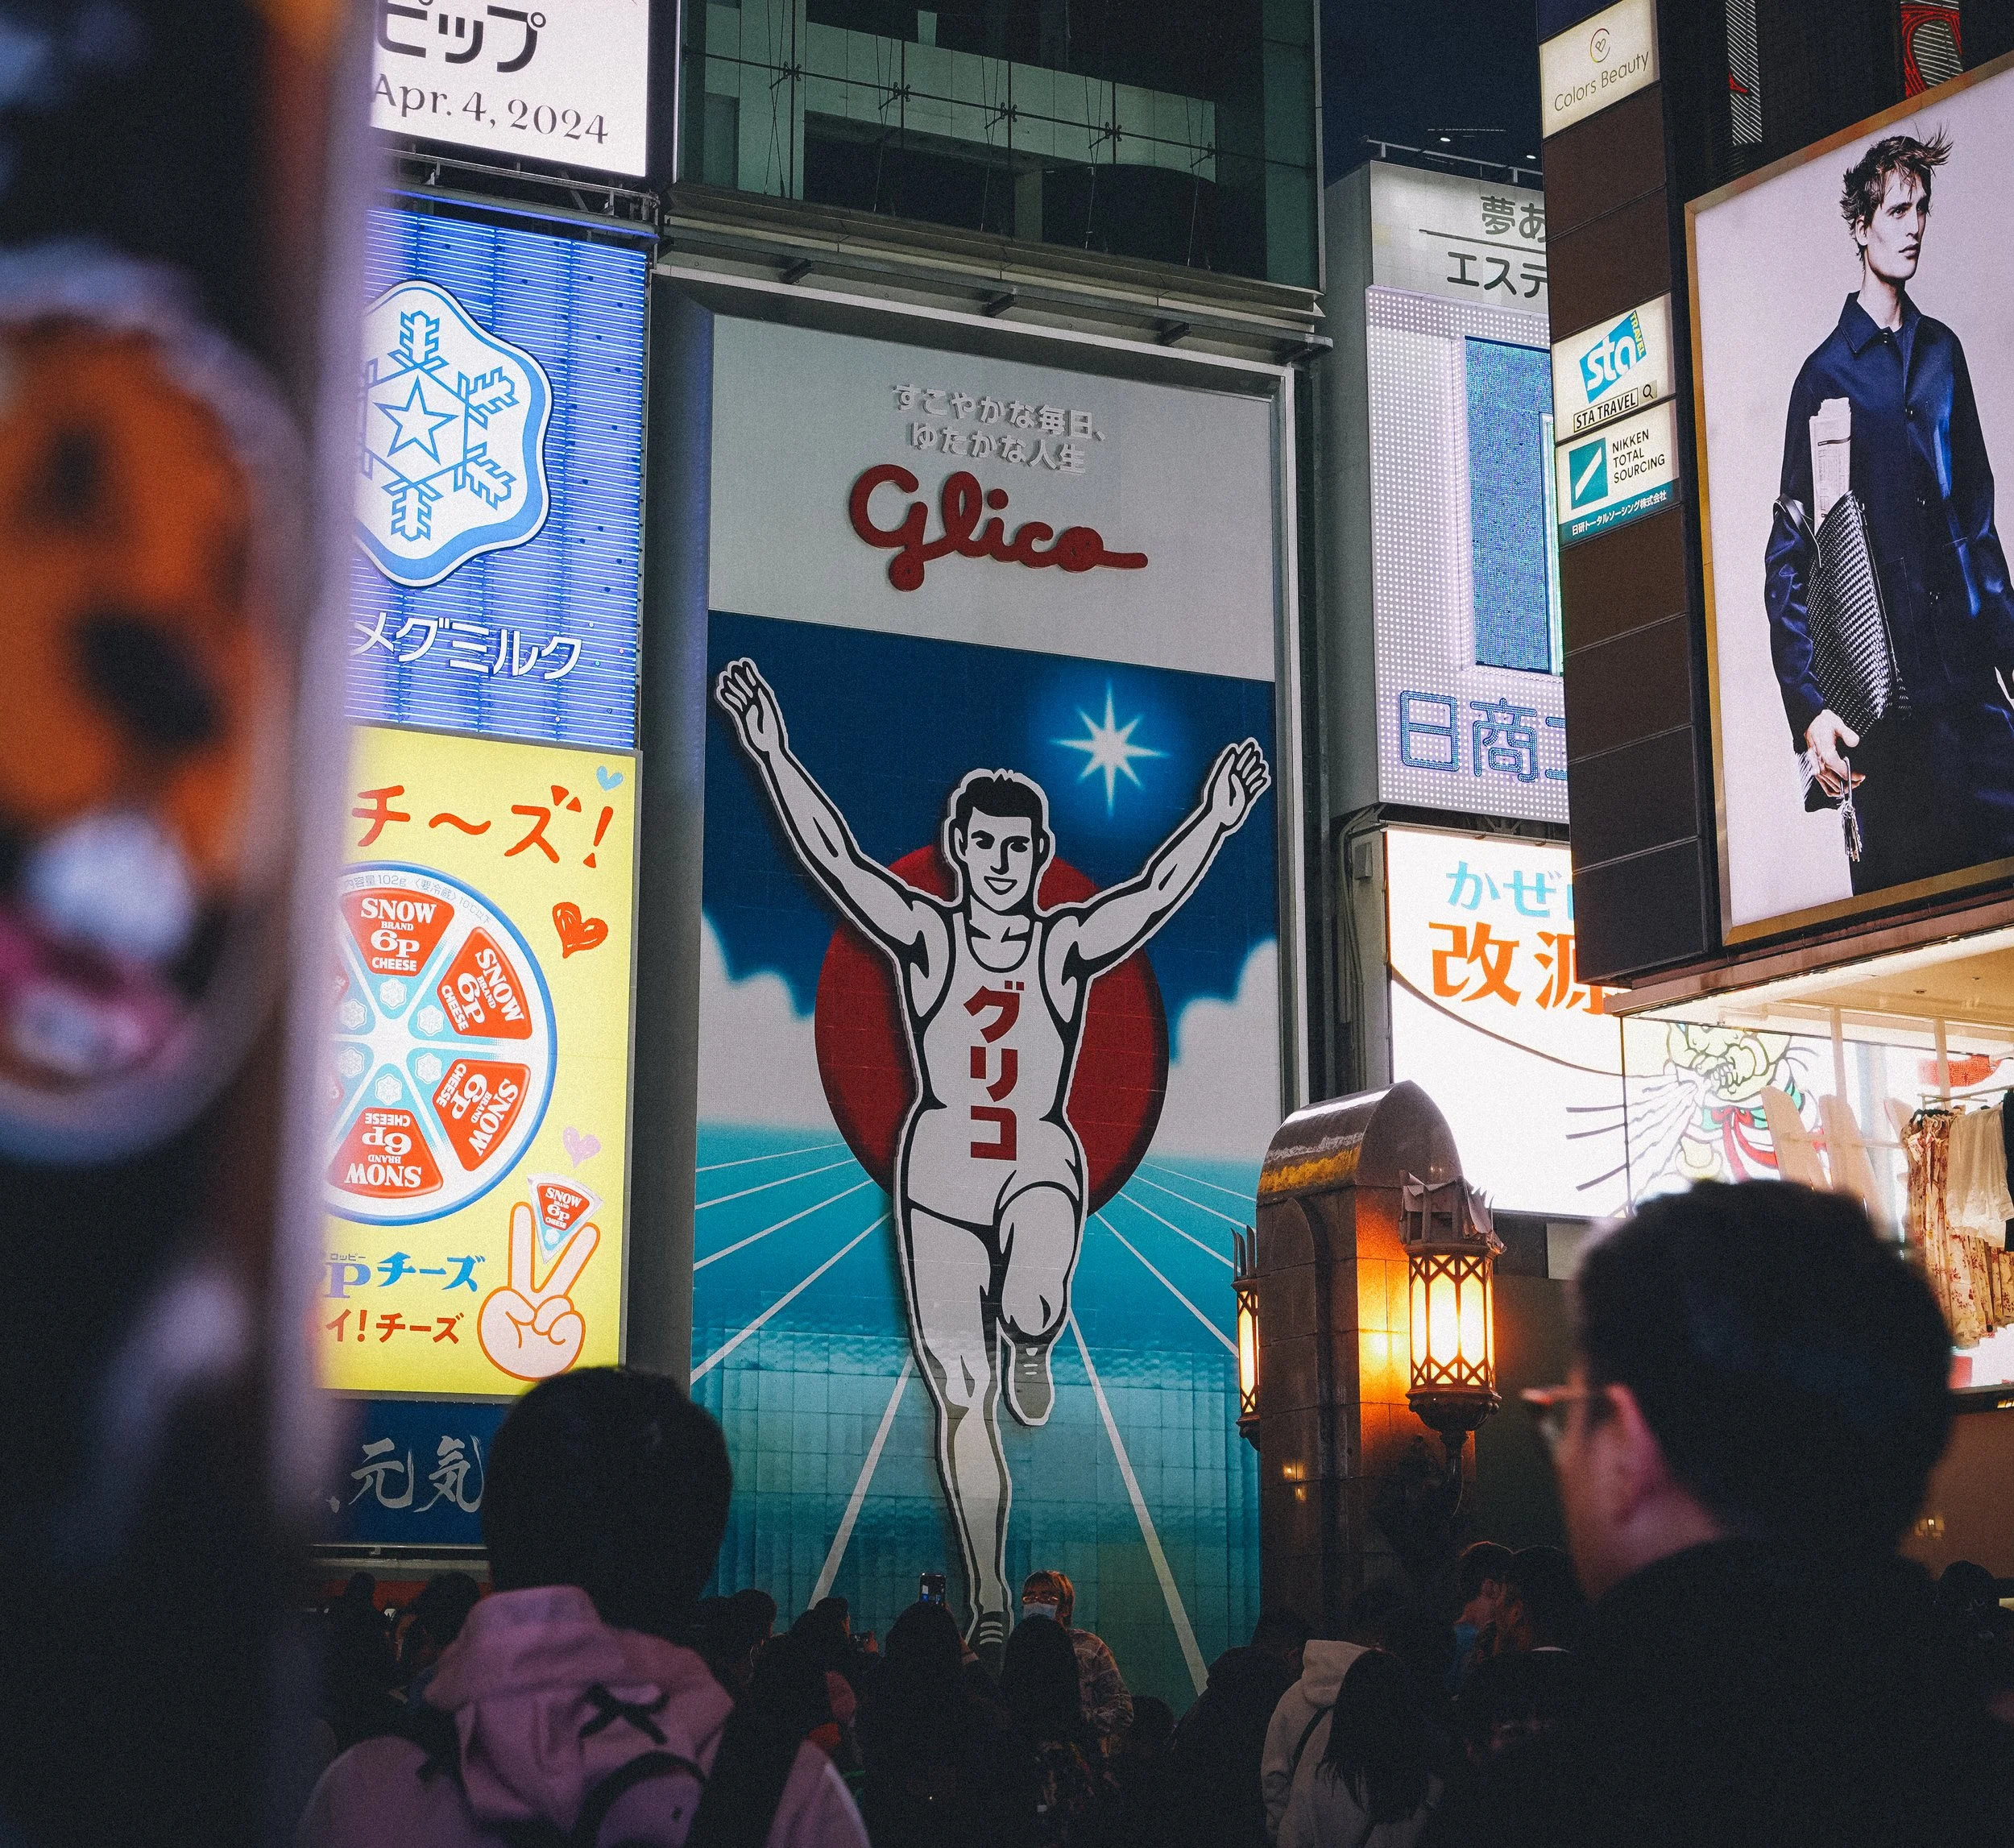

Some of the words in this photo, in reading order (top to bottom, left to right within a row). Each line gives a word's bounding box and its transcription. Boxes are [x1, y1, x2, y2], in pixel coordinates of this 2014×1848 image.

[1554, 80, 1597, 112] Colors
[1601, 51, 1649, 89] Beauty
[375, 73, 452, 118] Apr.
[462, 91, 496, 130] 4,
[508, 99, 608, 145] 2024
[1480, 196, 1546, 243] 夢あ
[1447, 251, 1548, 299] エステ
[1630, 311, 1645, 357] TRAVEL
[892, 383, 1106, 441] すこやかな毎日、
[1576, 411, 1595, 429] STA
[1597, 392, 1637, 421] TRAVEL
[911, 421, 1086, 474] ゆたかな人生
[1612, 429, 1649, 453] NIKKEN
[1613, 447, 1644, 468] TOTAL
[1614, 454, 1665, 483] SOURCING
[849, 464, 1149, 591] Glico
[1572, 490, 1667, 537] 日研トータルソーシング株式会社
[350, 611, 582, 680] メグミルク
[360, 897, 437, 924] SNOW
[1445, 860, 1575, 922] かぜ
[371, 929, 420, 958] 6P
[381, 920, 414, 931] BRAND
[371, 956, 417, 972] CHEESE
[475, 948, 525, 1021] SNOW
[441, 984, 470, 1032] CHEESE
[457, 972, 485, 1024] 6P
[476, 975, 497, 1009] BRAND
[436, 1063, 467, 1108] CHEESE
[963, 980, 1024, 1161] グリコ
[450, 1074, 487, 1120] 6P
[468, 1078, 519, 1157] SNOW
[470, 1091, 493, 1124] BRAND
[362, 1126, 412, 1156] 6P
[364, 1113, 411, 1128] CHEESE
[344, 1162, 422, 1188] SNOW
[367, 1154, 402, 1164] BRAND
[545, 1187, 582, 1208] SNOW
[546, 1204, 570, 1222] 6P
[330, 1253, 367, 1262] ロッピー
